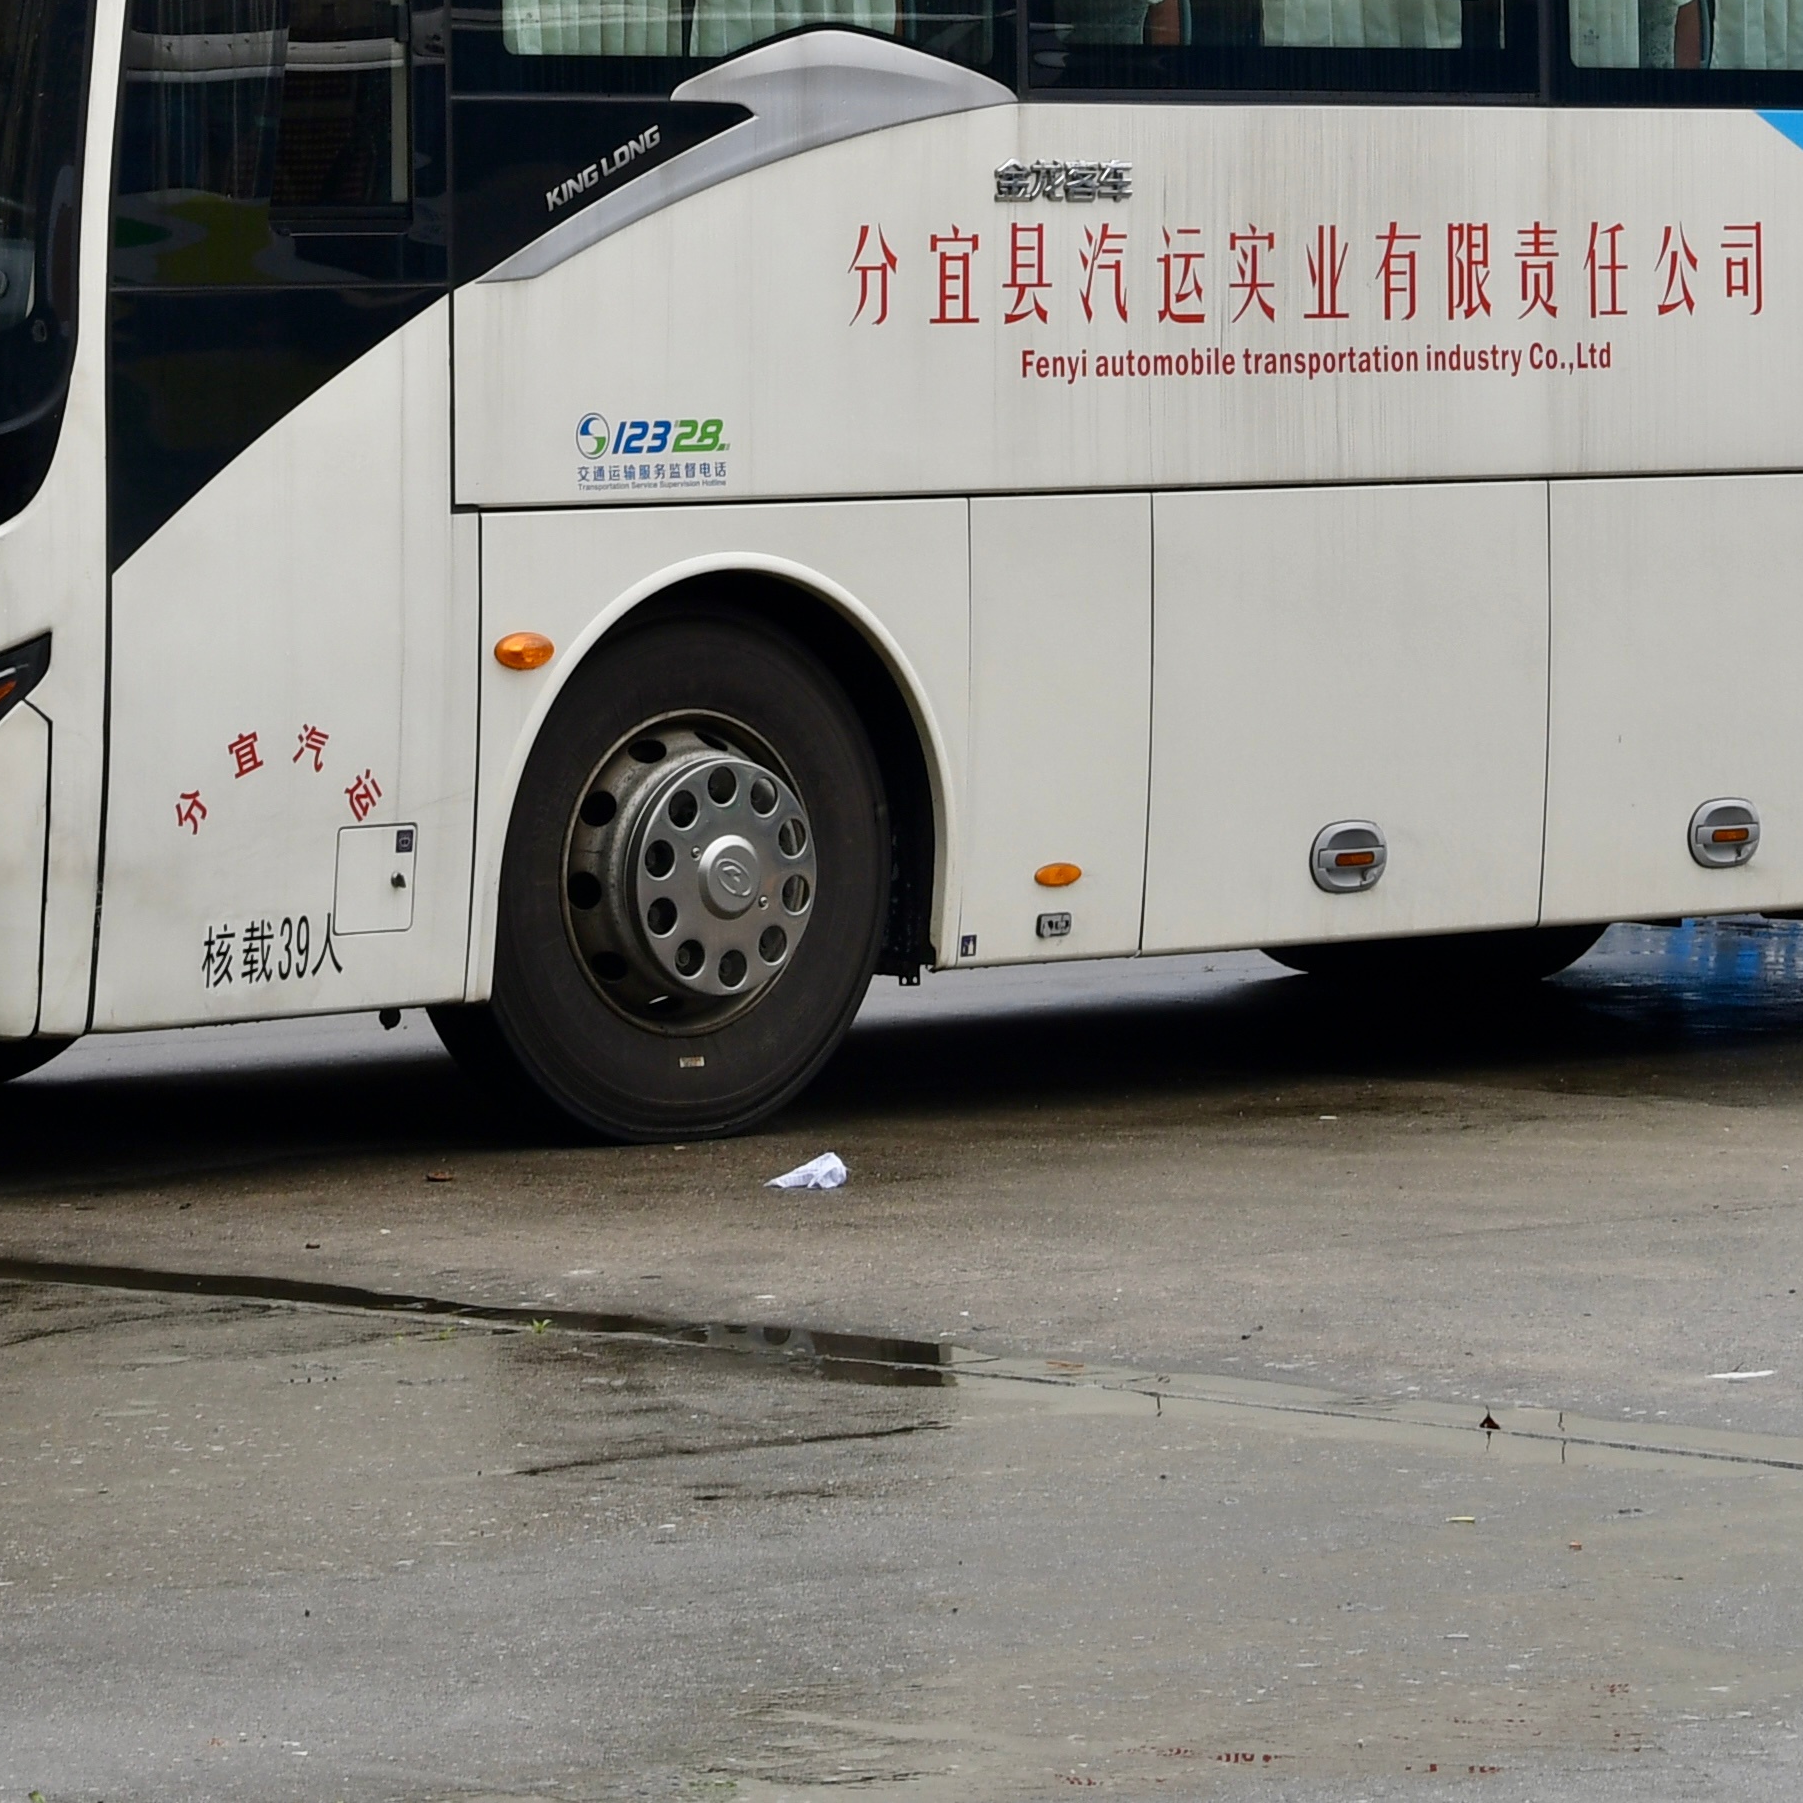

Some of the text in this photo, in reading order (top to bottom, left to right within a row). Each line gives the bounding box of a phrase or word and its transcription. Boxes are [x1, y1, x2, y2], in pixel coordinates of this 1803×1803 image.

[546, 124, 661, 212] KING LONG
[995, 158, 1133, 203] 金龙客车
[847, 221, 1764, 327] 分宜县汽运实业有限责任公司
[1021, 341, 1612, 385] Fenyi automobile transportation industry Co.,Ltd
[577, 461, 727, 482] 交通运输服务监督电话
[578, 479, 727, 492] Transportation Service Supervision Hotline
[175, 723, 383, 836] 分宜汽运
[201, 912, 343, 989] 核载39人
